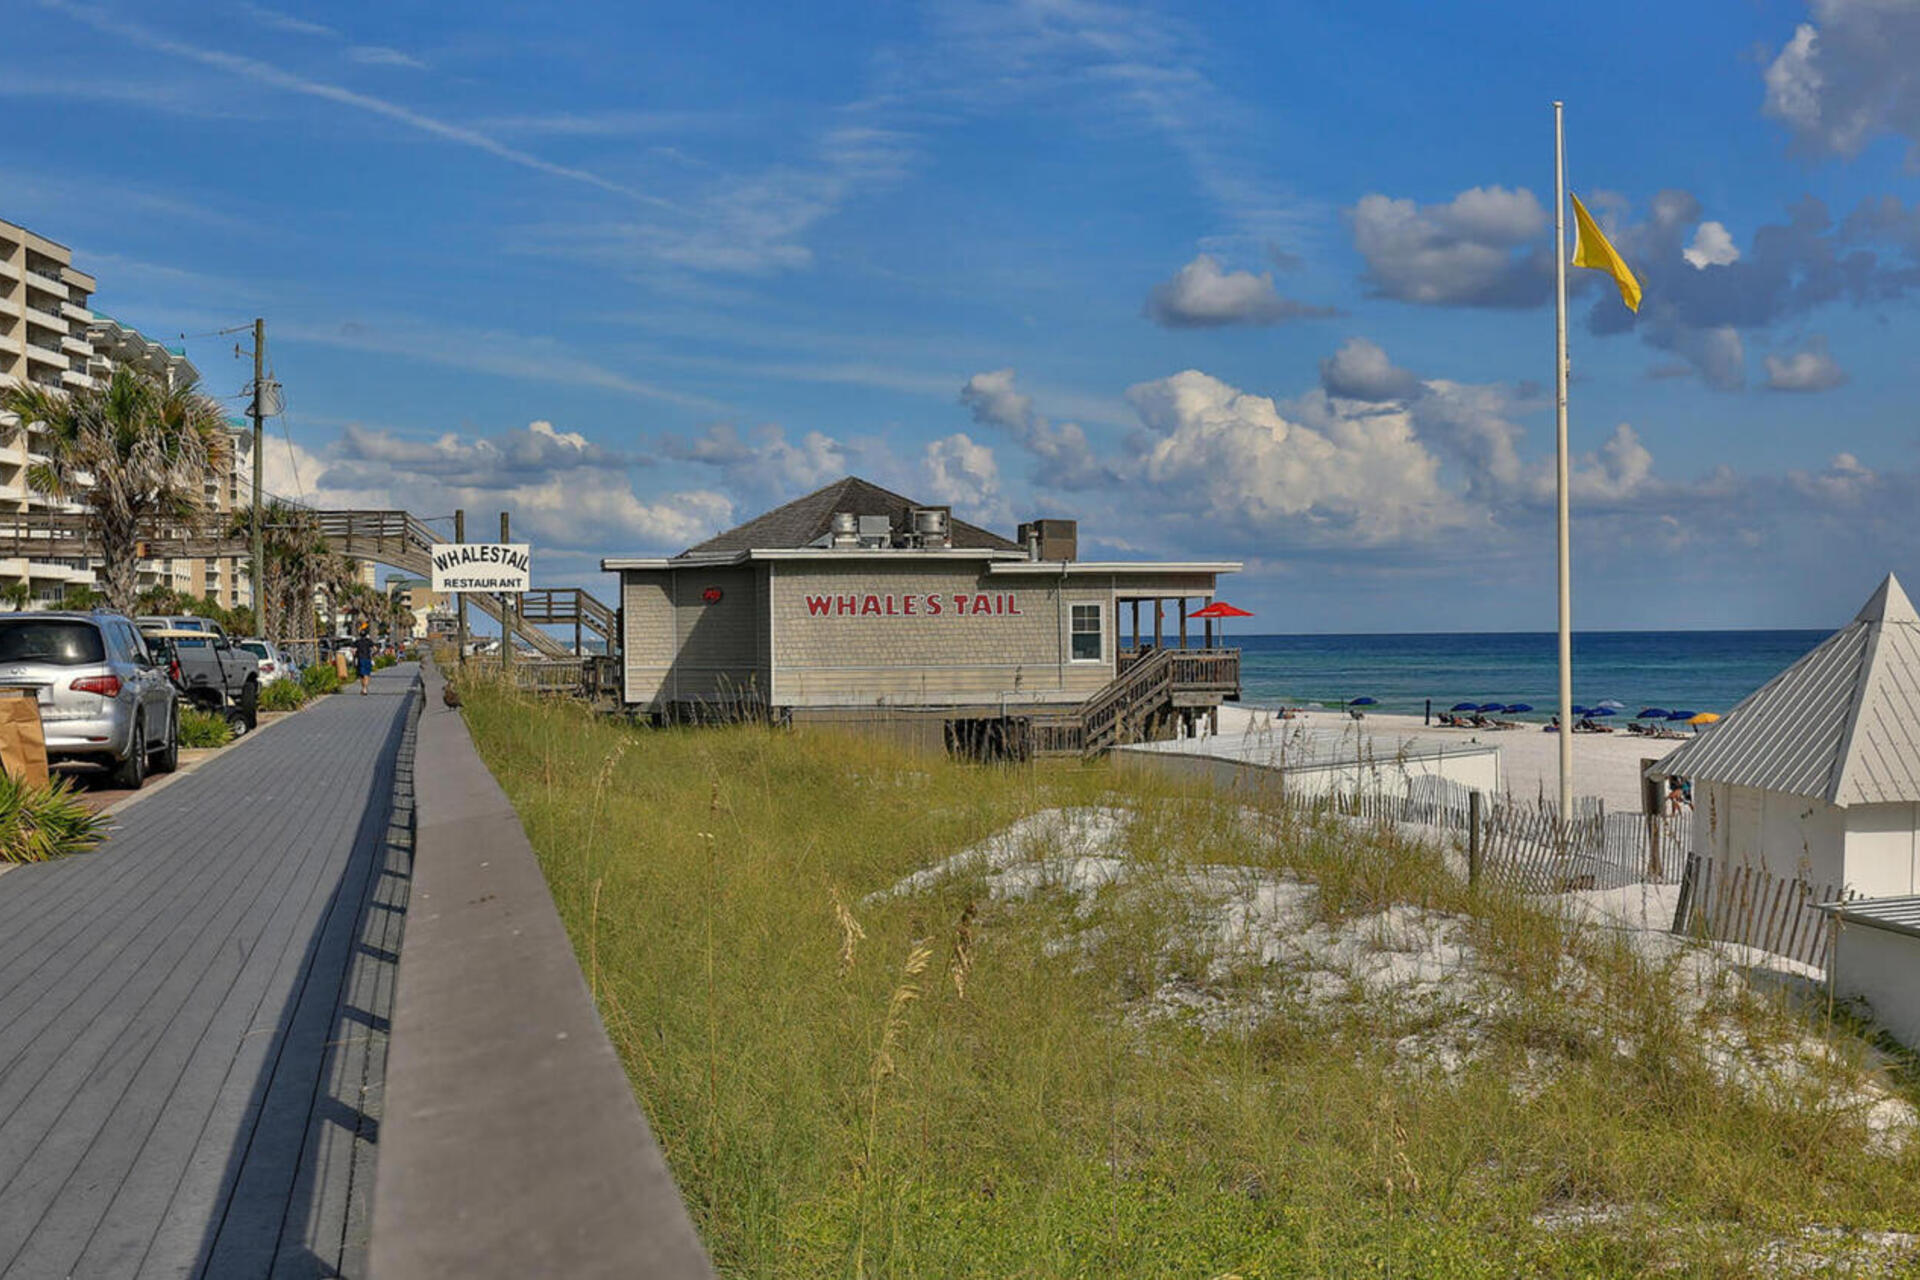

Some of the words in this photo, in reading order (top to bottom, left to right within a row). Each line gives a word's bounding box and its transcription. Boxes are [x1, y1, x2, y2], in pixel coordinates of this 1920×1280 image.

[433, 546, 529, 573] WHALESTAIL
[444, 578, 522, 588] RESTAURANT
[804, 594, 942, 617] WHALE'S
[952, 594, 1023, 616] TAIL
